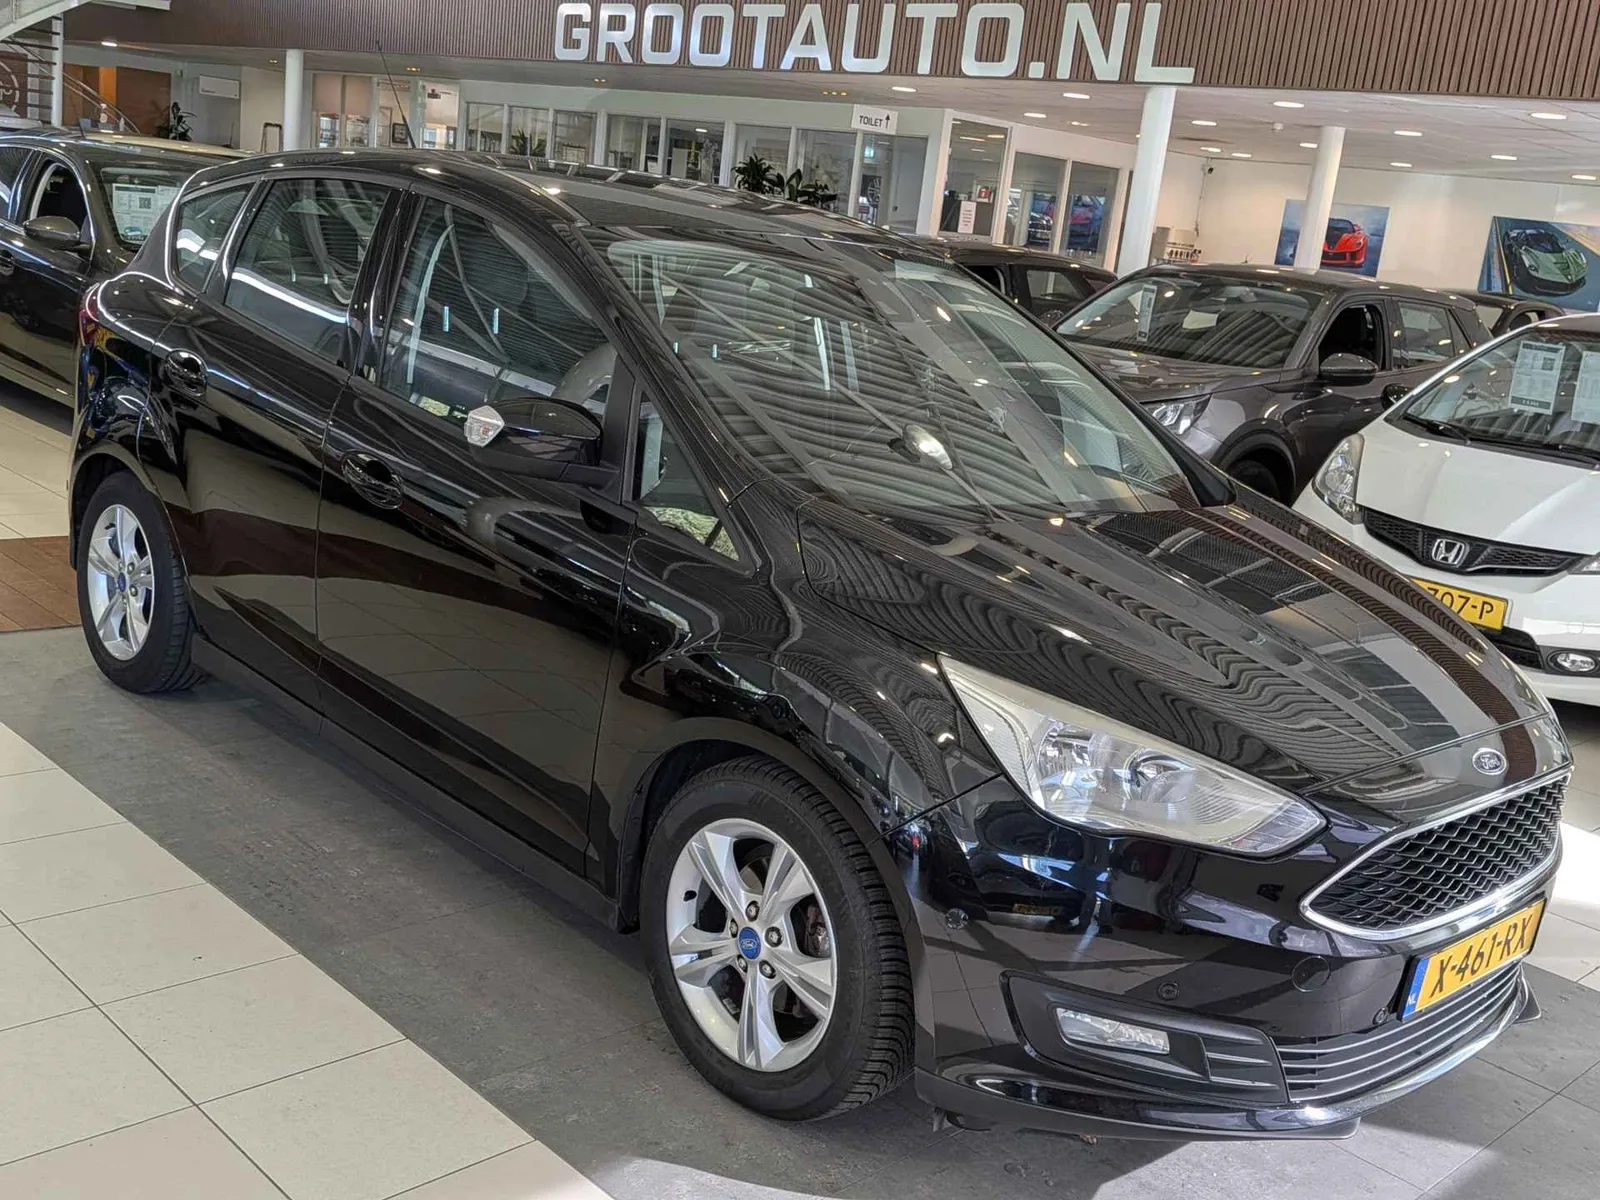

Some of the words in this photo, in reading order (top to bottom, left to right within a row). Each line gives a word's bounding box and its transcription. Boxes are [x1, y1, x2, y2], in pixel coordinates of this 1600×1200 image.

[554, 3, 1195, 84] GROOTAUTO.NL
[859, 114, 883, 127] TOILET
[1429, 914, 1533, 998] X-461-RX
